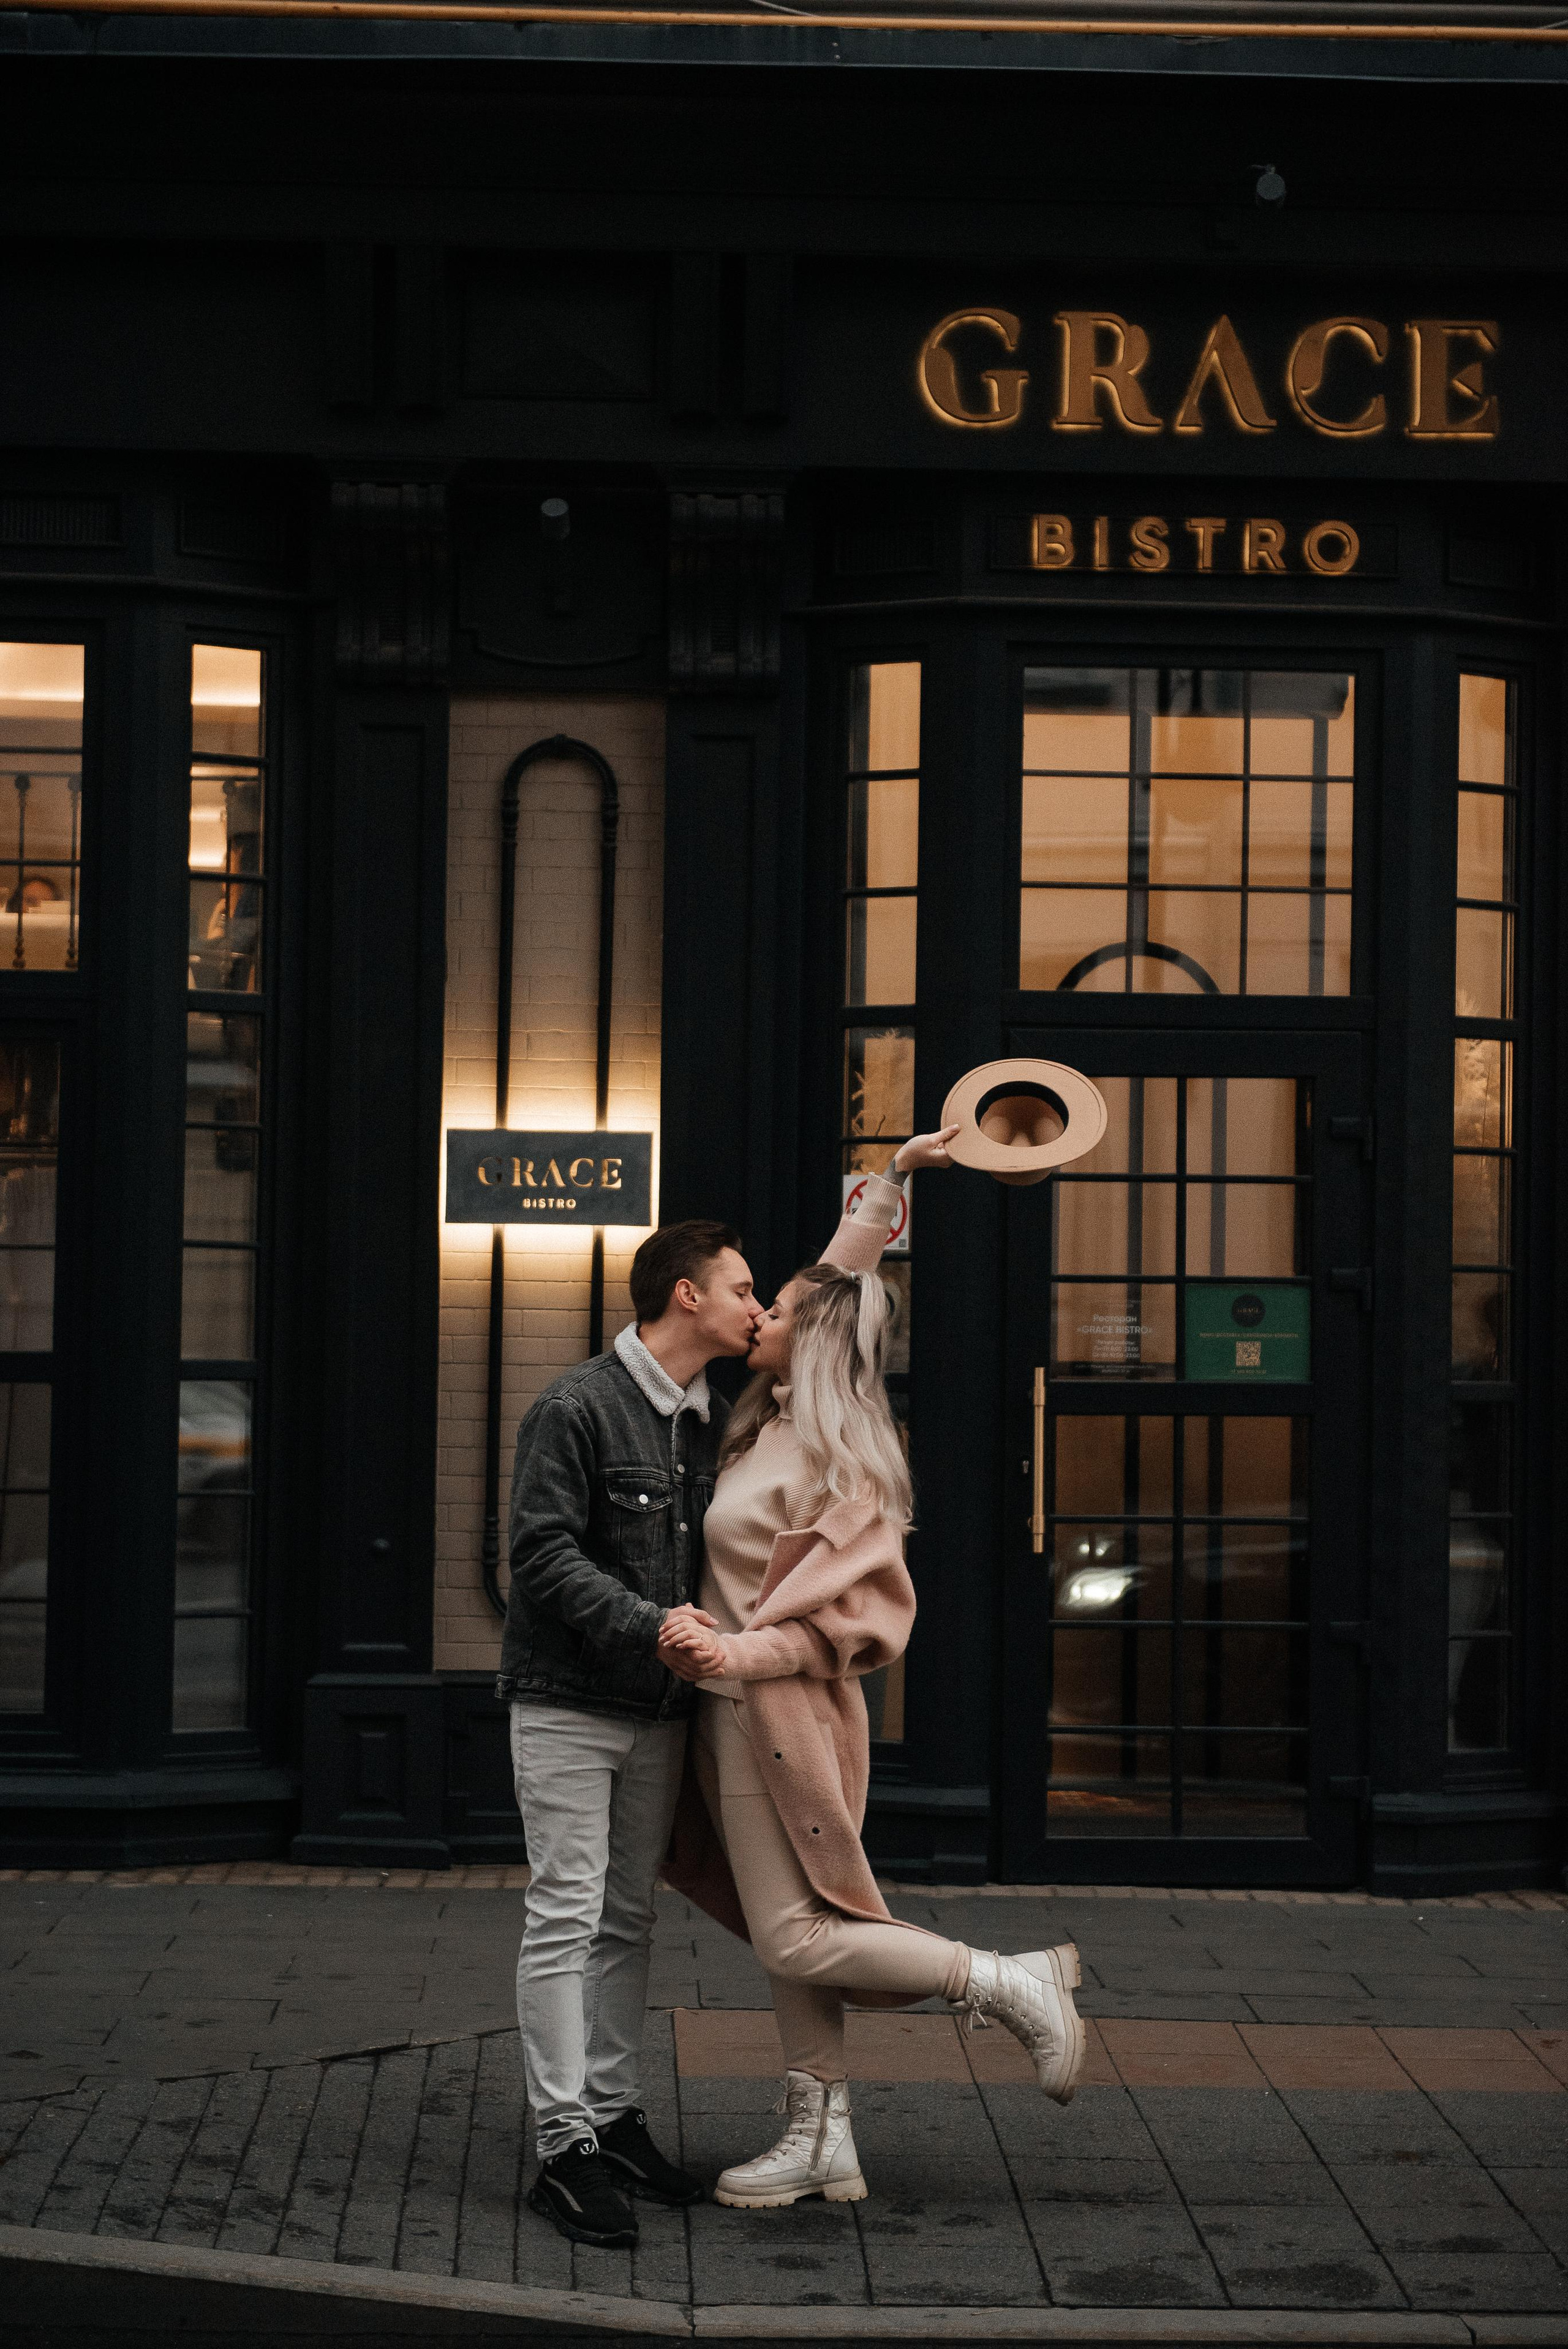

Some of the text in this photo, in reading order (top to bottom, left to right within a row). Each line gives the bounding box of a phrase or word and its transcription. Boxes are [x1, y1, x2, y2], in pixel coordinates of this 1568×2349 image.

[918, 308, 1499, 437] GRACE
[1033, 513, 1360, 575] BISTRO
[477, 1156, 622, 1189] GRACE
[522, 1198, 577, 1209] BISTRO
[1093, 1314, 1137, 1323] Ресторан
